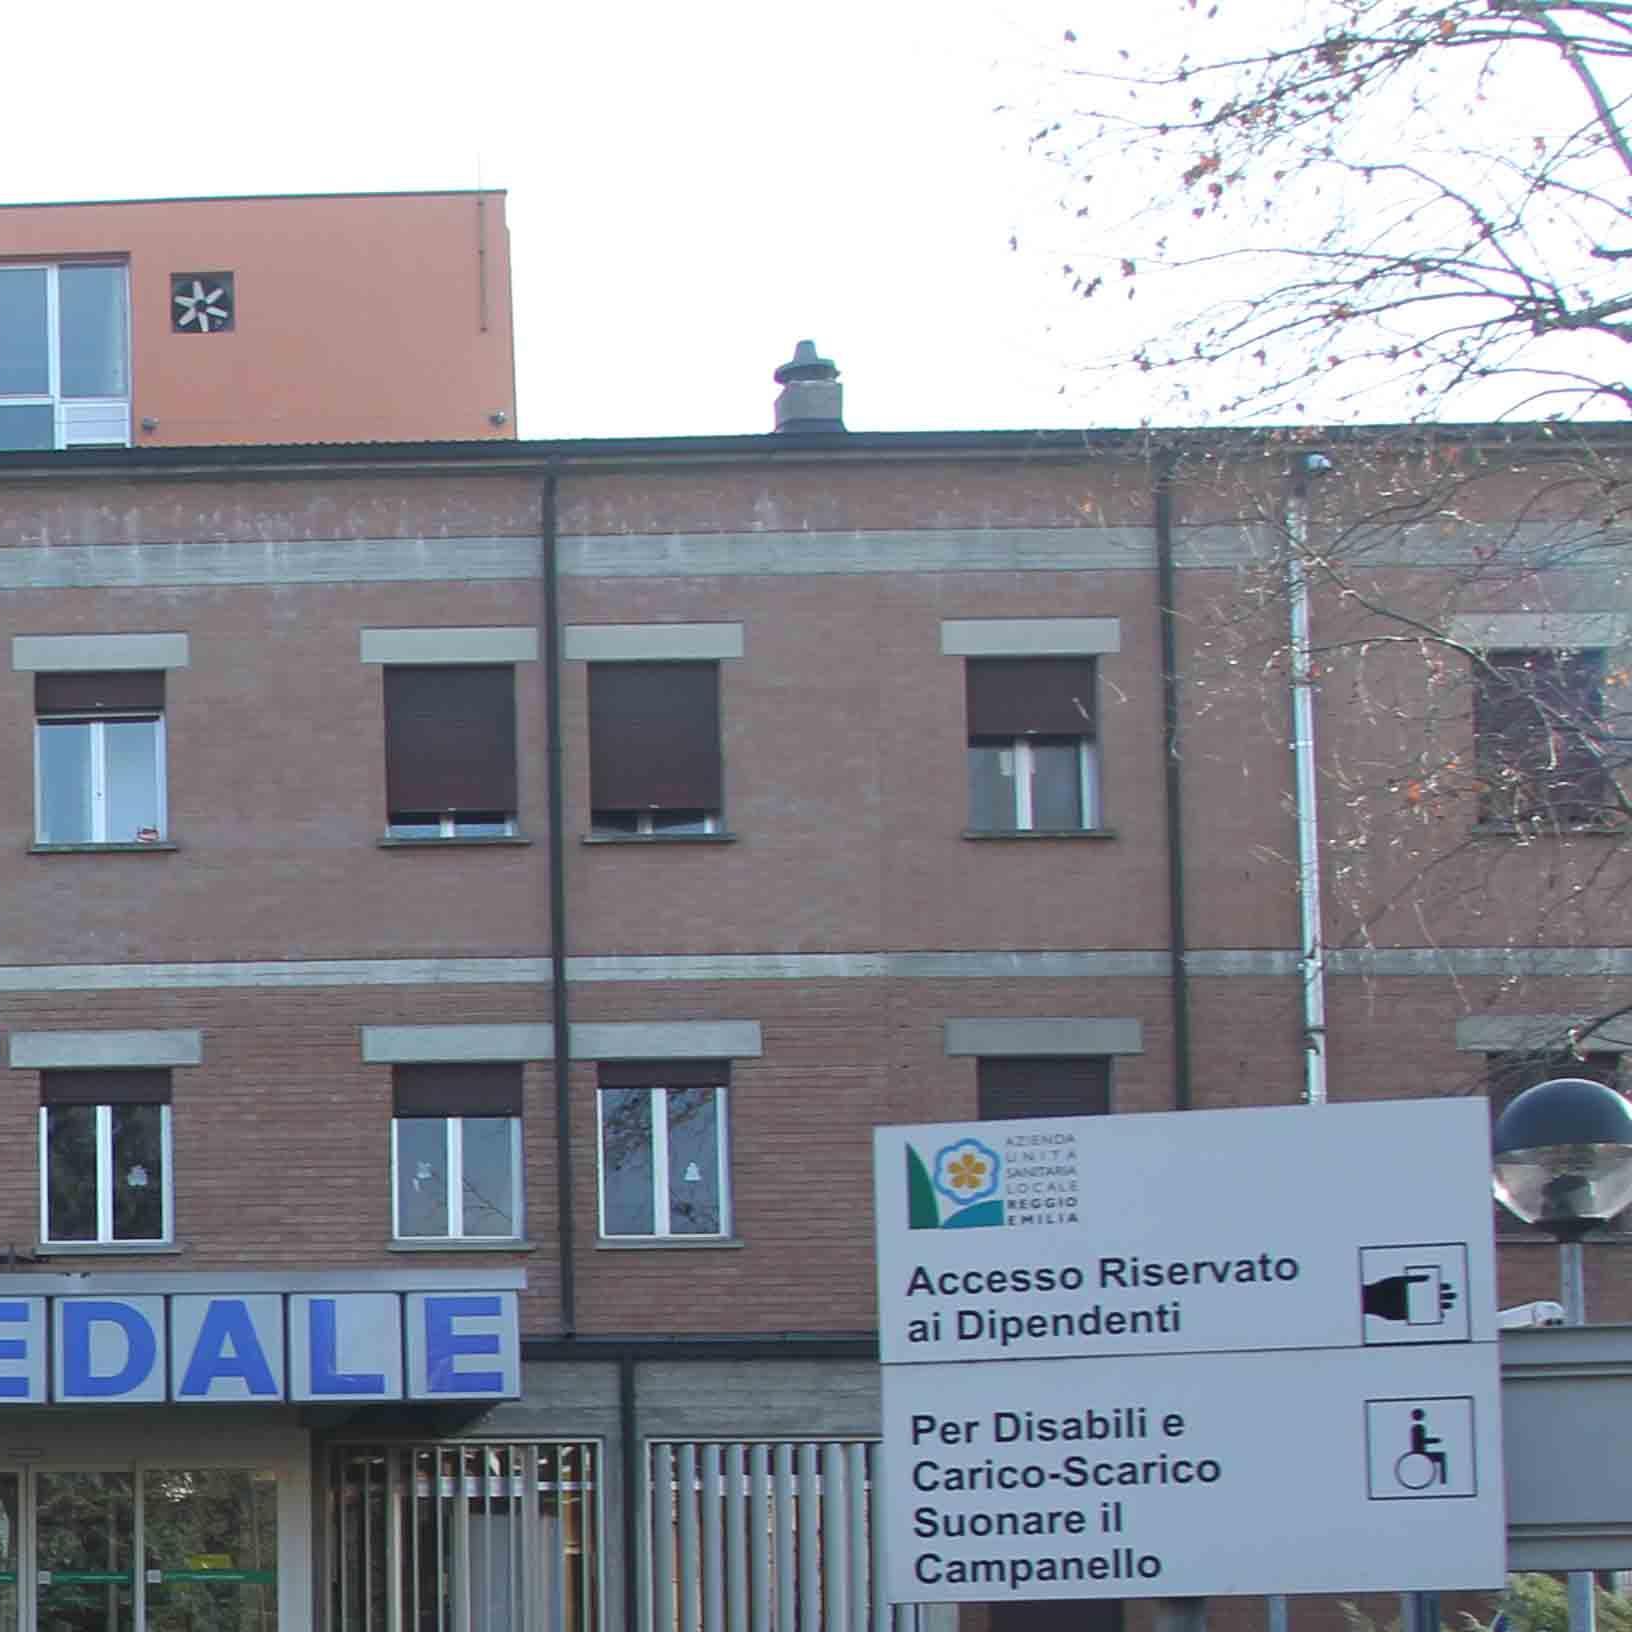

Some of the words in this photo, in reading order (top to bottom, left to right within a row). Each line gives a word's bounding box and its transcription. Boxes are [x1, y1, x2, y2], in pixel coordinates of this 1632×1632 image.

[1005, 1133, 1076, 1147] AZIENDA
[1006, 1180, 1079, 1194] LOCALE
[1007, 1196, 1078, 1210] REGGIO
[1007, 1213, 1079, 1226] EMILIA
[907, 1264, 1084, 1298] Accesso
[1100, 1253, 1301, 1288] Riservato
[908, 1310, 940, 1342] ai
[957, 1303, 1182, 1346] Dipendenti
[911, 1413, 979, 1446] Per
[994, 1408, 1147, 1443] Disabili
[1162, 1415, 1185, 1438] e
[912, 1453, 1222, 1491] Carico-Scarico
[914, 1505, 1086, 1538] Suonare
[1100, 1501, 1123, 1534] il
[915, 1549, 1162, 1589] Campanello
